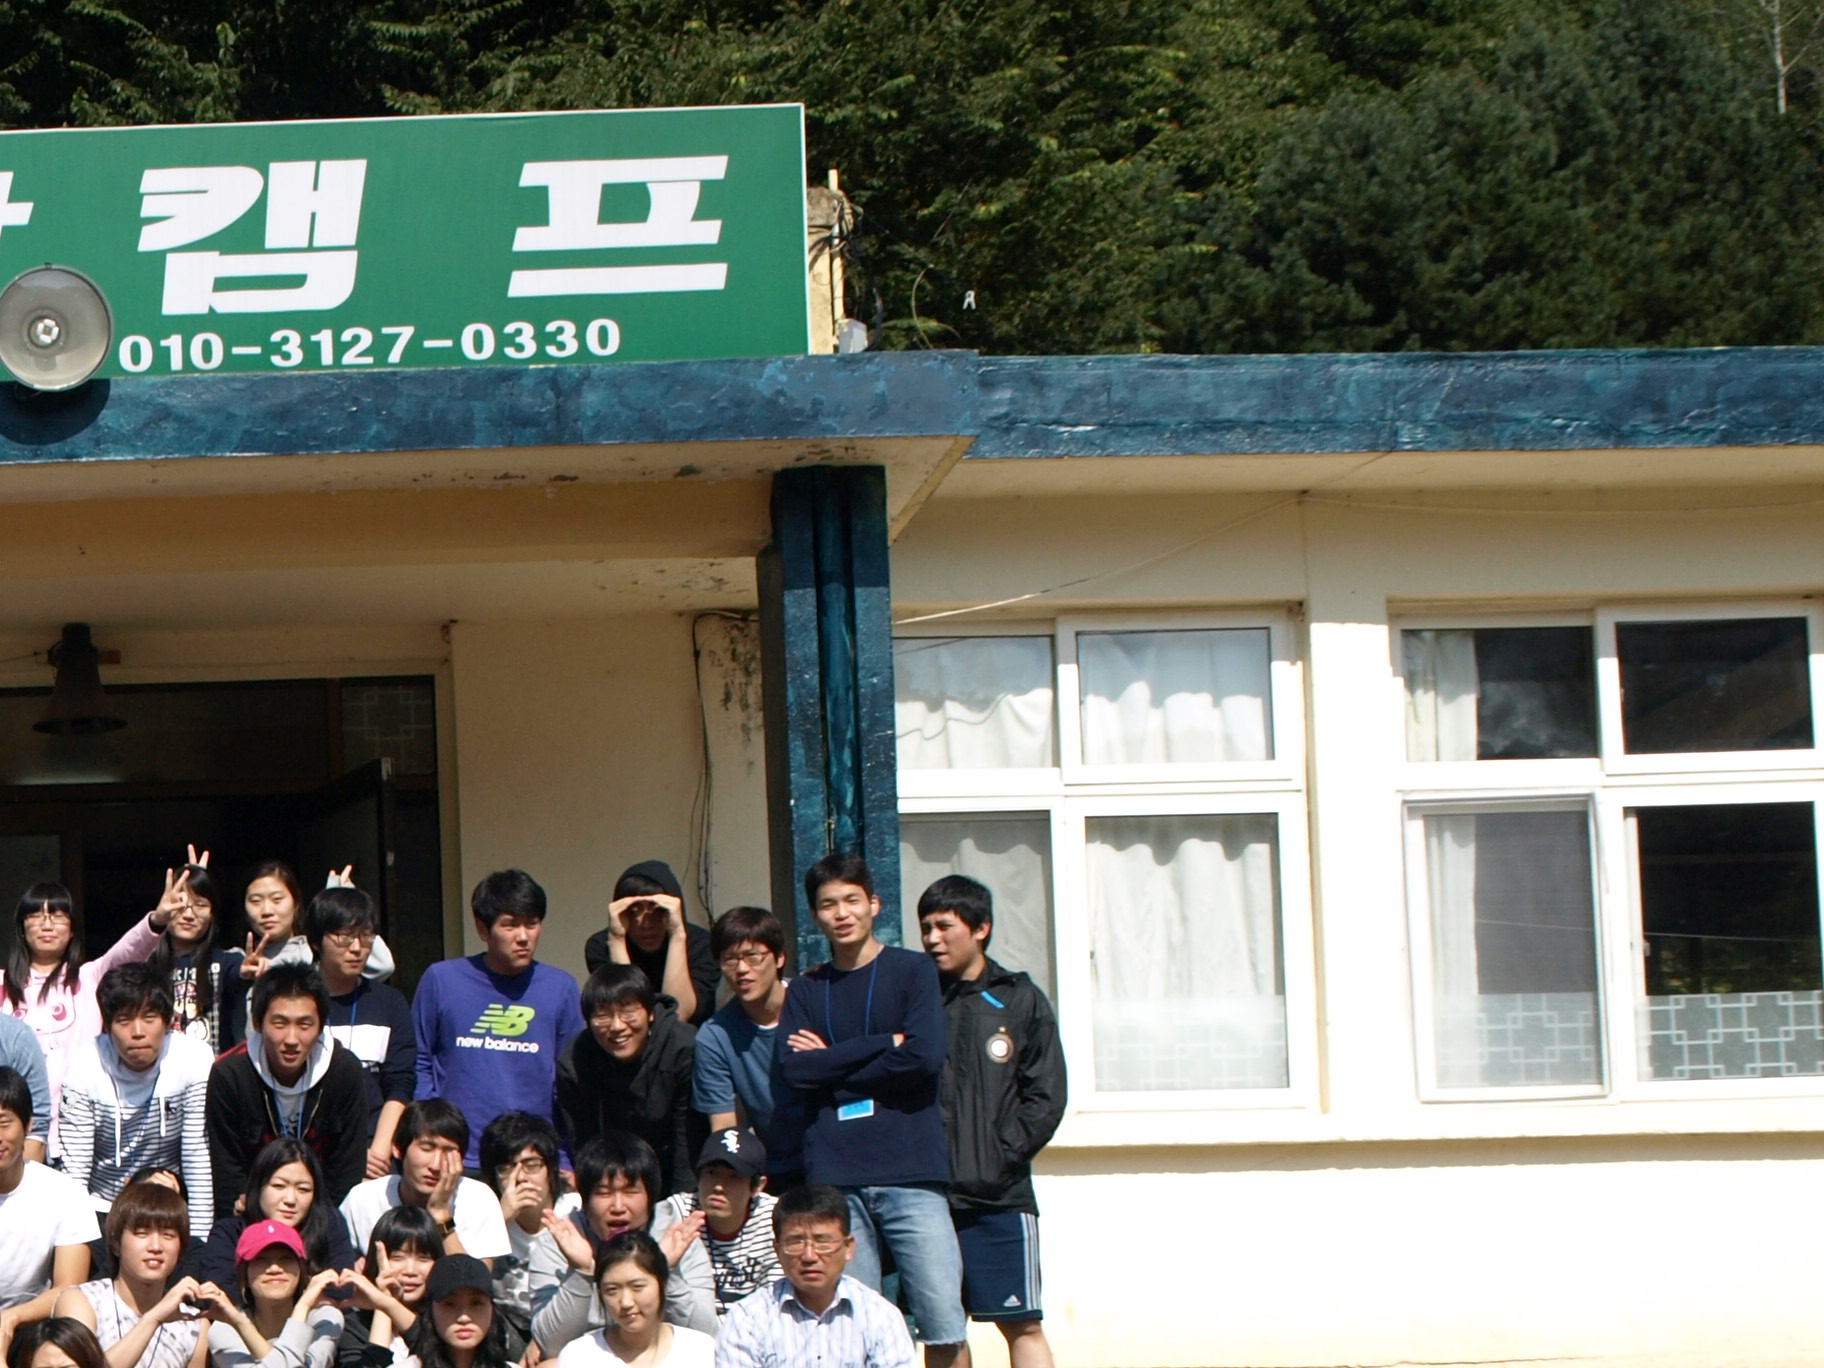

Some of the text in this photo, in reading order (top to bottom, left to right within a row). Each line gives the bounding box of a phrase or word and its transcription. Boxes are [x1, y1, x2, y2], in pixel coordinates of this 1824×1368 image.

[118, 318, 622, 373] 010-3127-0330
[456, 1036, 540, 1054] new balance
